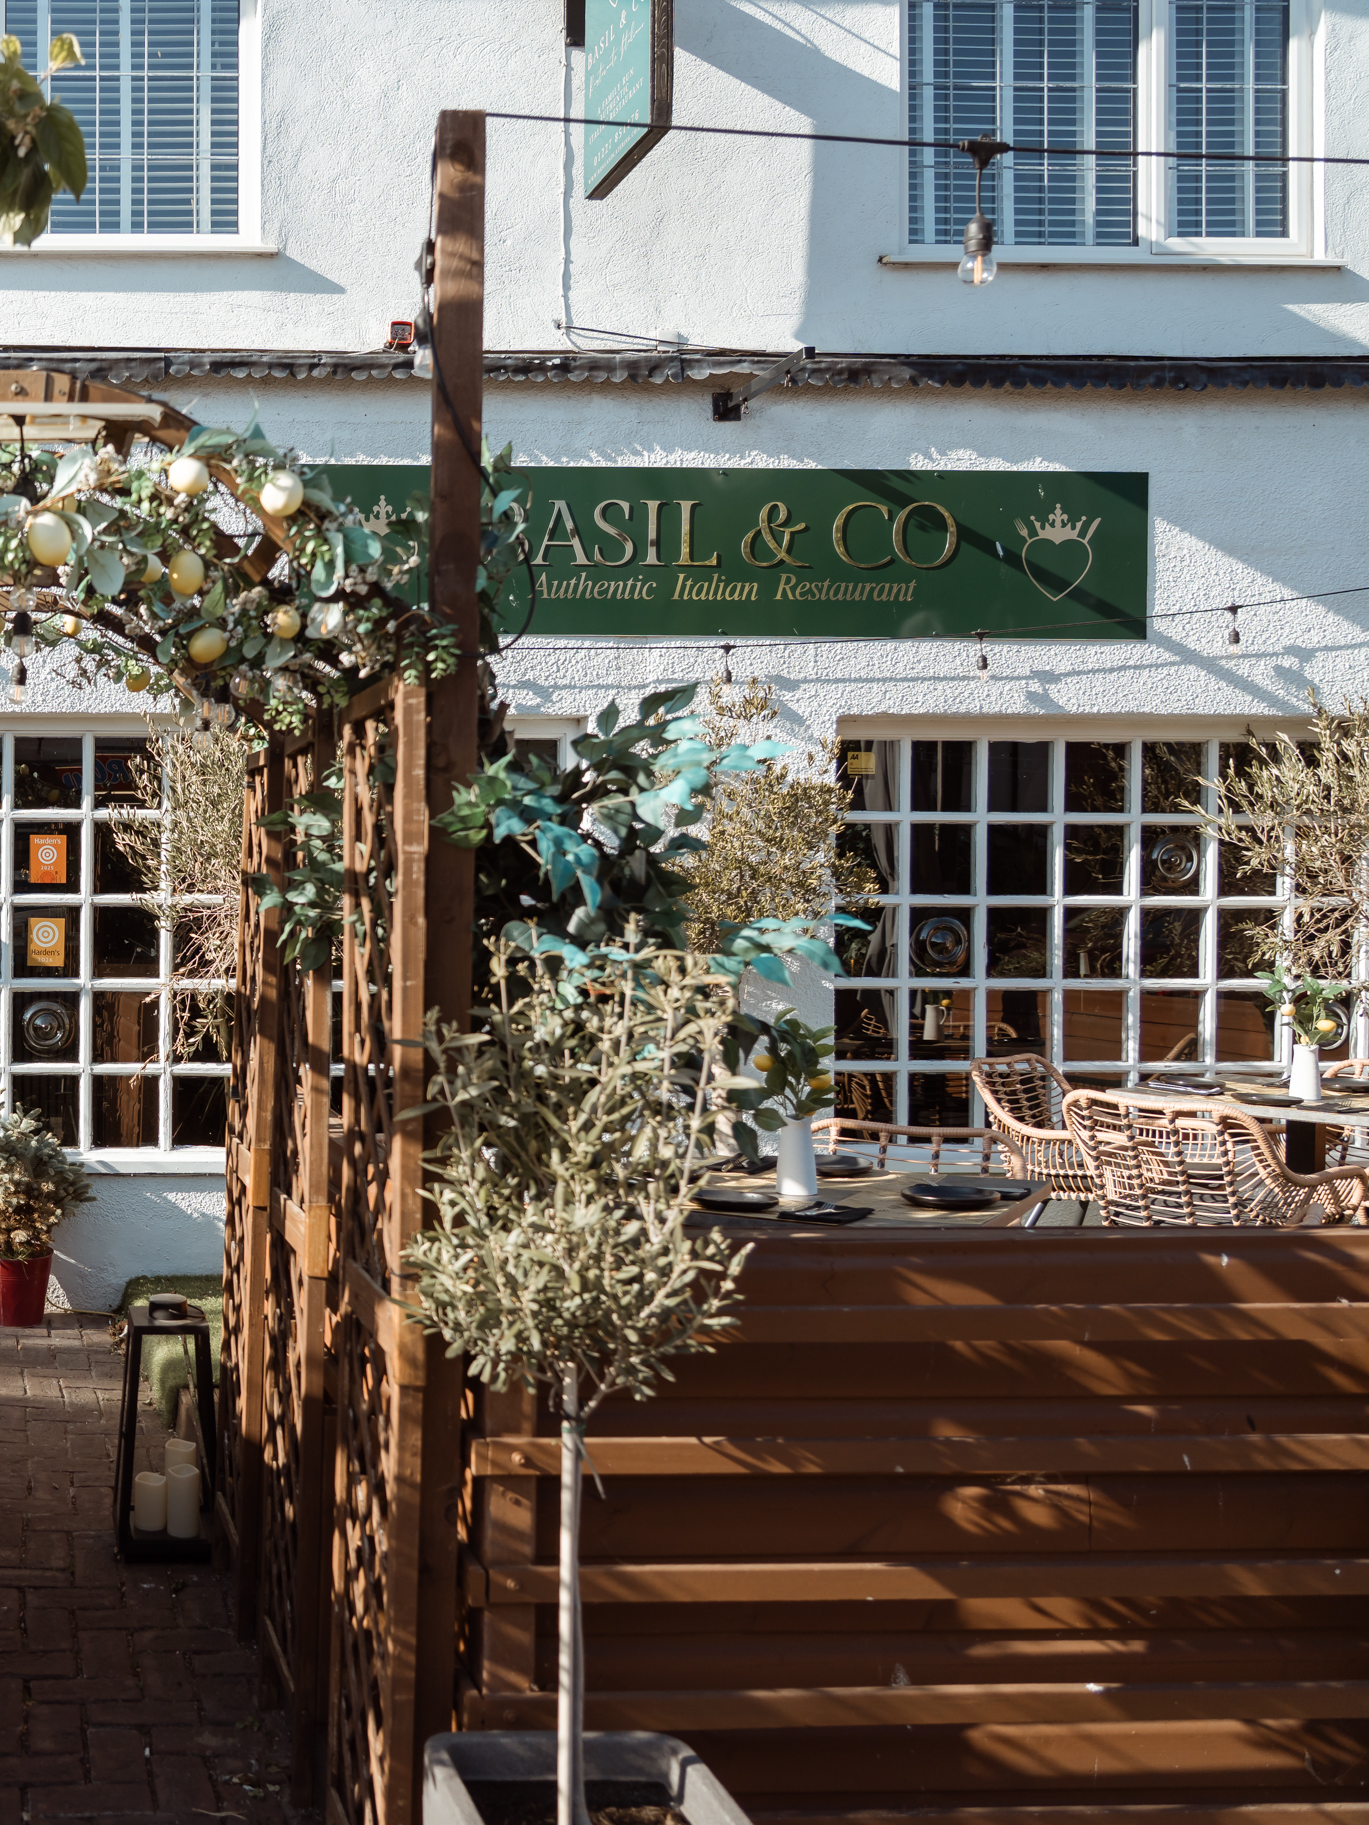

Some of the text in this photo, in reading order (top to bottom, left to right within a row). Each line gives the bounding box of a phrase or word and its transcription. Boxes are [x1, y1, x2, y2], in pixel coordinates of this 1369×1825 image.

[588, 24, 615, 71] BASIL
[620, 9, 627, 28] &
[600, 83, 629, 121] AUTHENTIC
[602, 81, 621, 110] FAMILY
[623, 66, 634, 86] RUN
[610, 77, 643, 121] RESTAURANT
[593, 138, 612, 166] 01227
[741, 501, 810, 568] &
[832, 501, 958, 569] CO
[527, 571, 917, 602] Authentic Italian Restaurant
[34, 837, 61, 845] Harden's
[31, 948, 61, 956] Harden's
